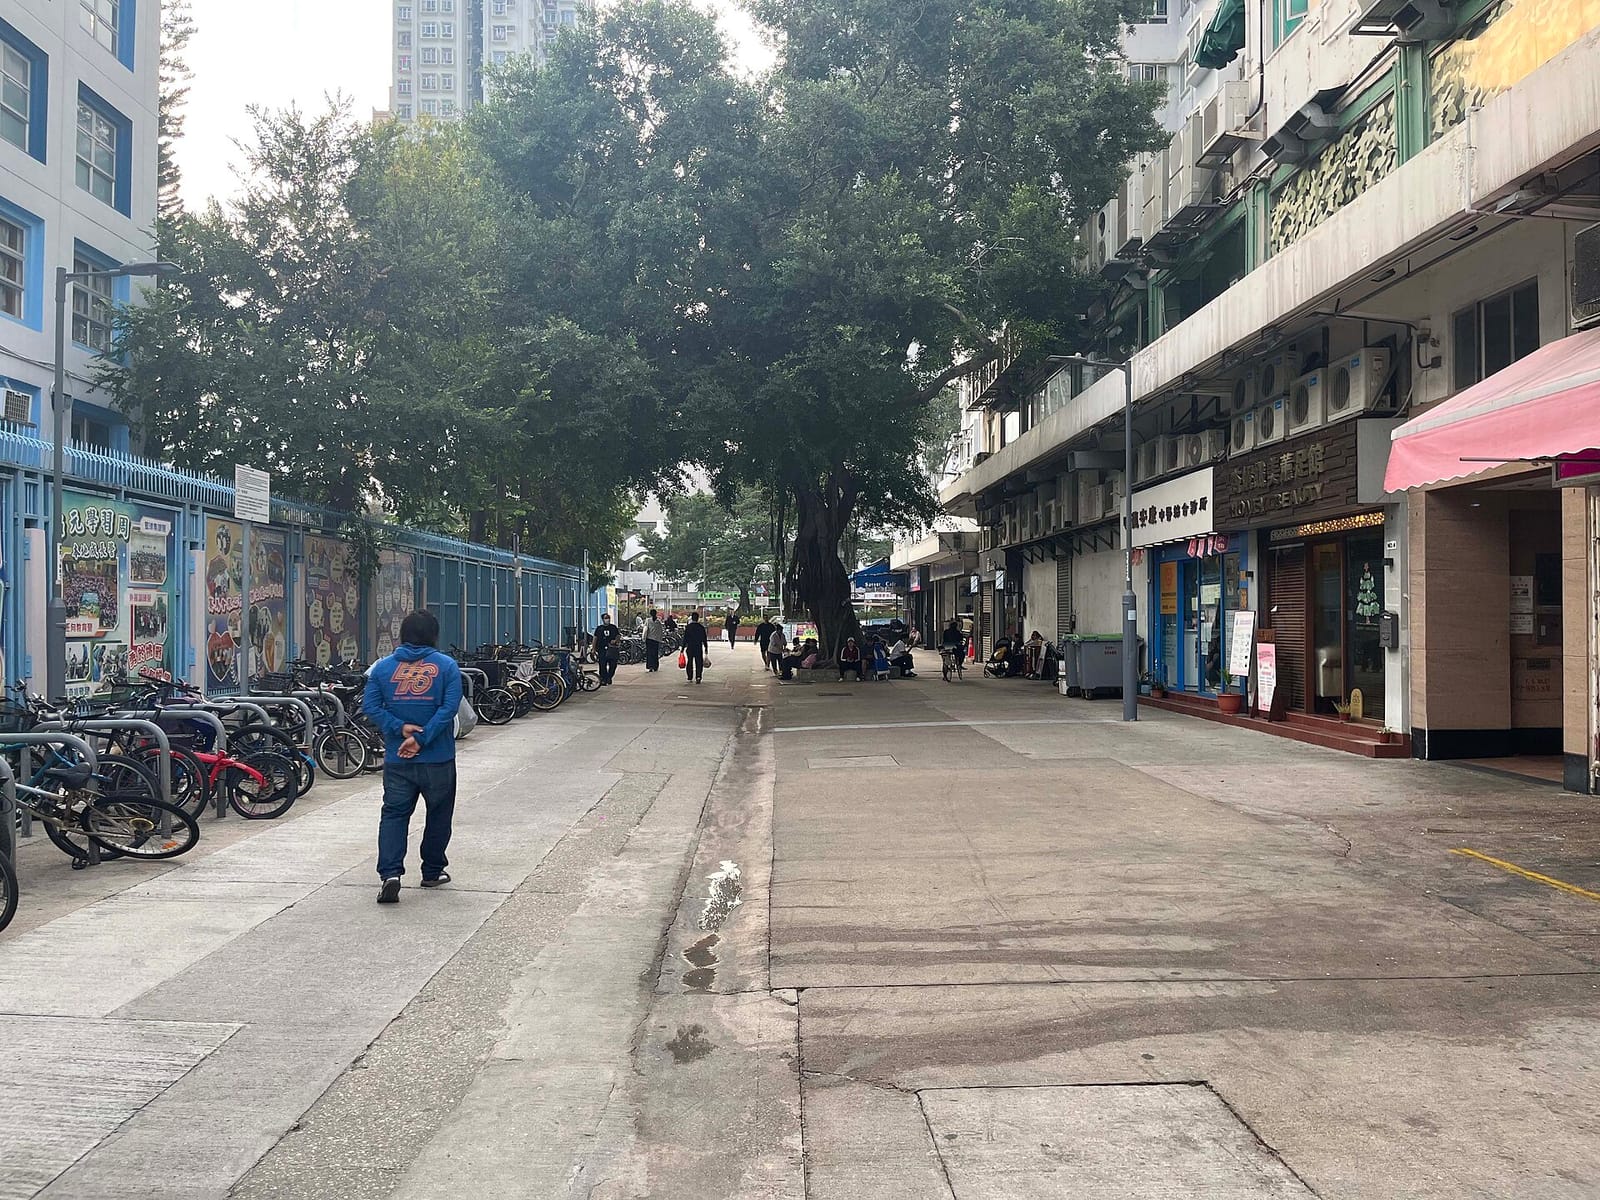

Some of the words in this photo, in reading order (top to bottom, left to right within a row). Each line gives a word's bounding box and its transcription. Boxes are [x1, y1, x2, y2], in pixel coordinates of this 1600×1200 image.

[1268, 483, 1325, 511] BEAUTY
[61, 506, 130, 541] 元學習周
